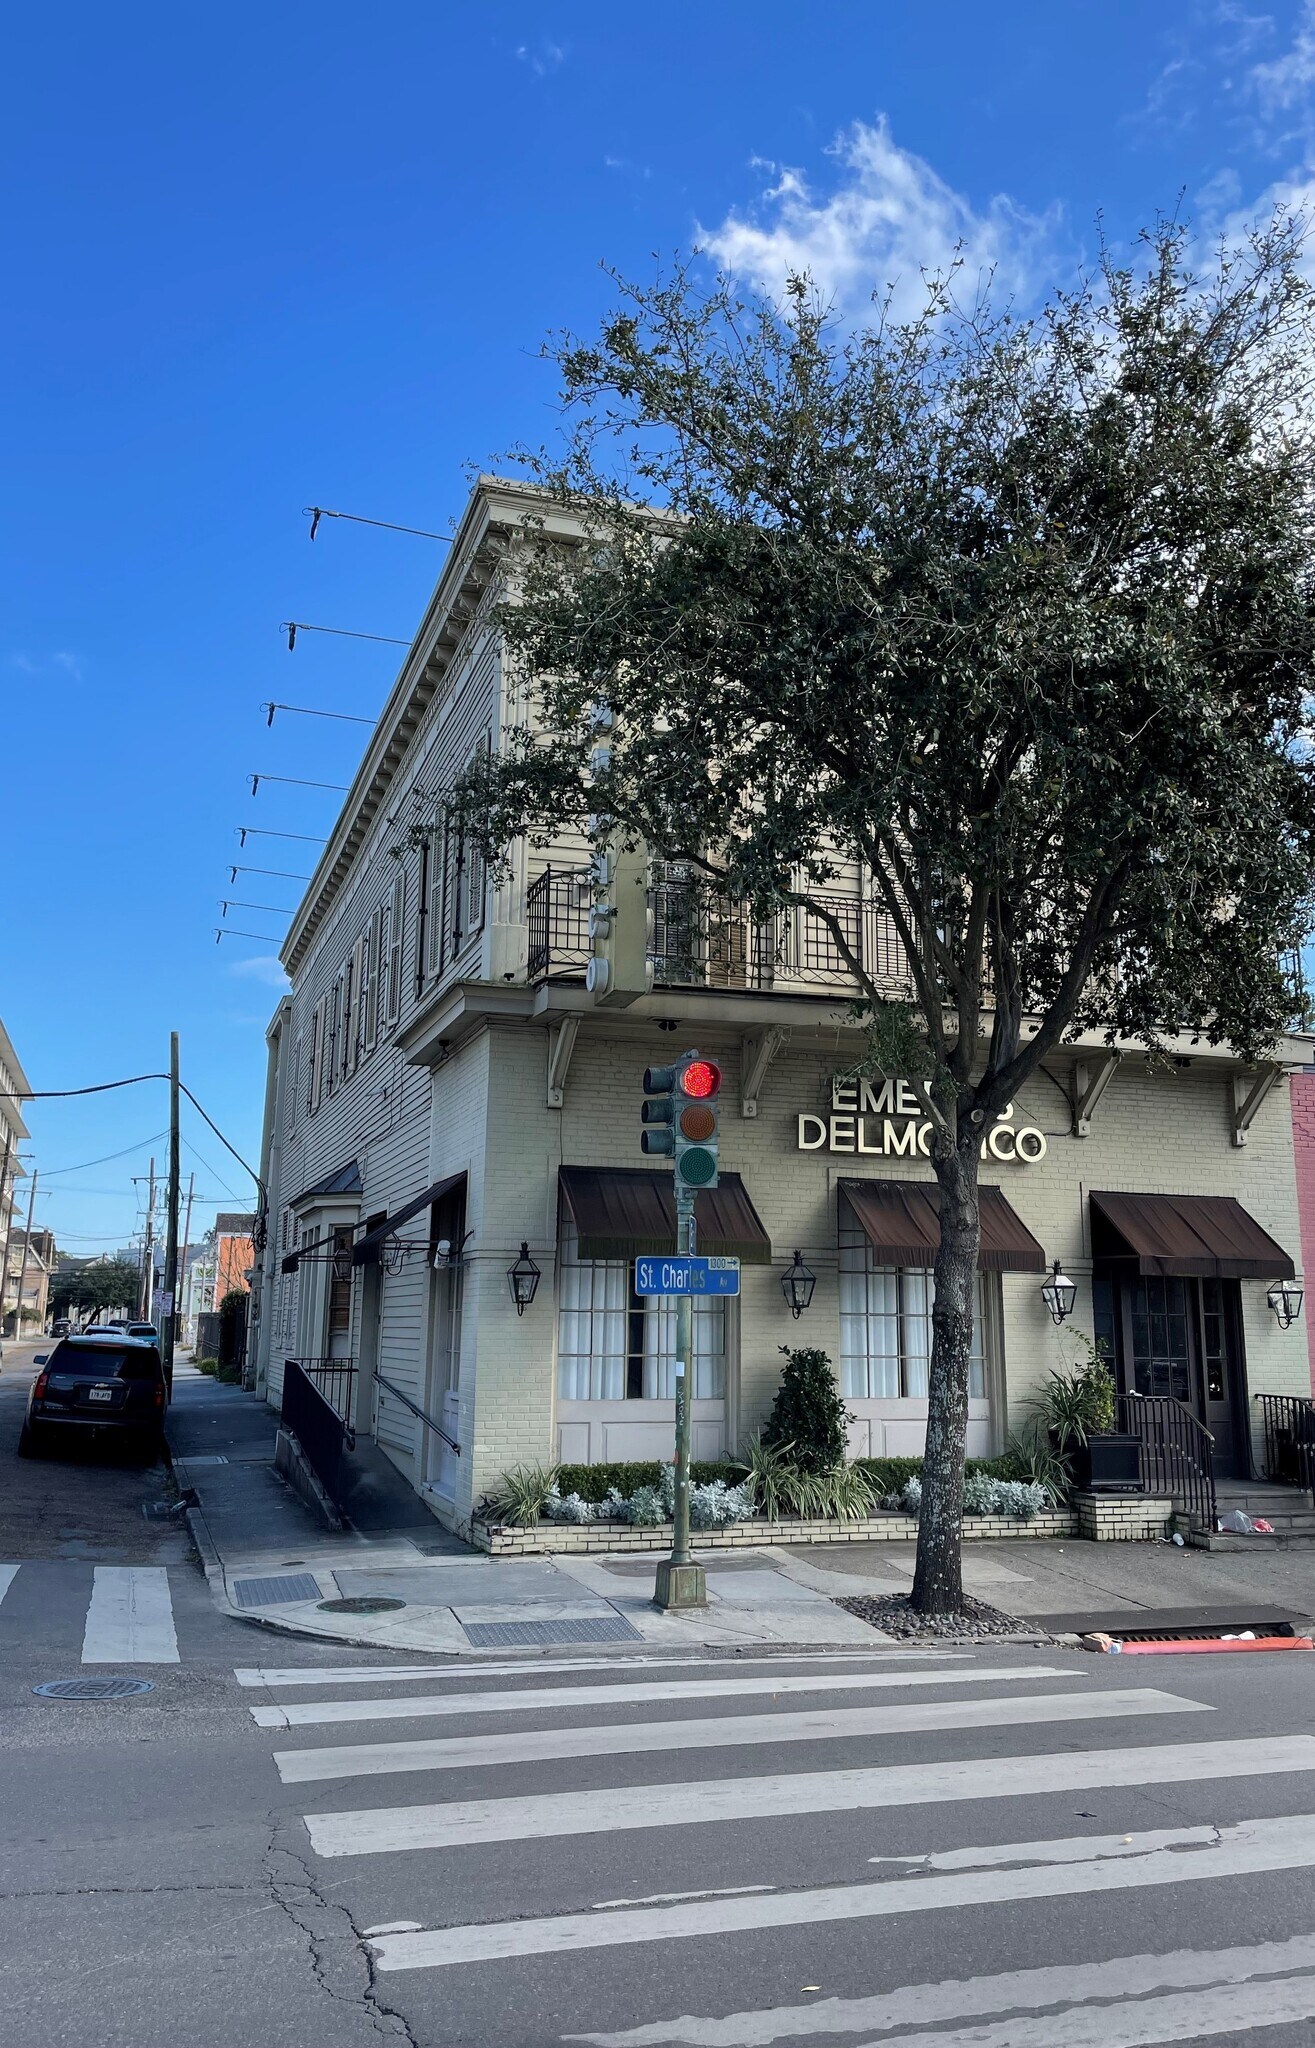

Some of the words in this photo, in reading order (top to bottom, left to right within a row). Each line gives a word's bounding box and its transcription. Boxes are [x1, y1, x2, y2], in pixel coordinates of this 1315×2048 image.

[798, 1113, 1048, 1163] DELMOICO
[640, 1263, 657, 1289] St.
[662, 1263, 706, 1289] Charles
[710, 1258, 726, 1269] 1300
